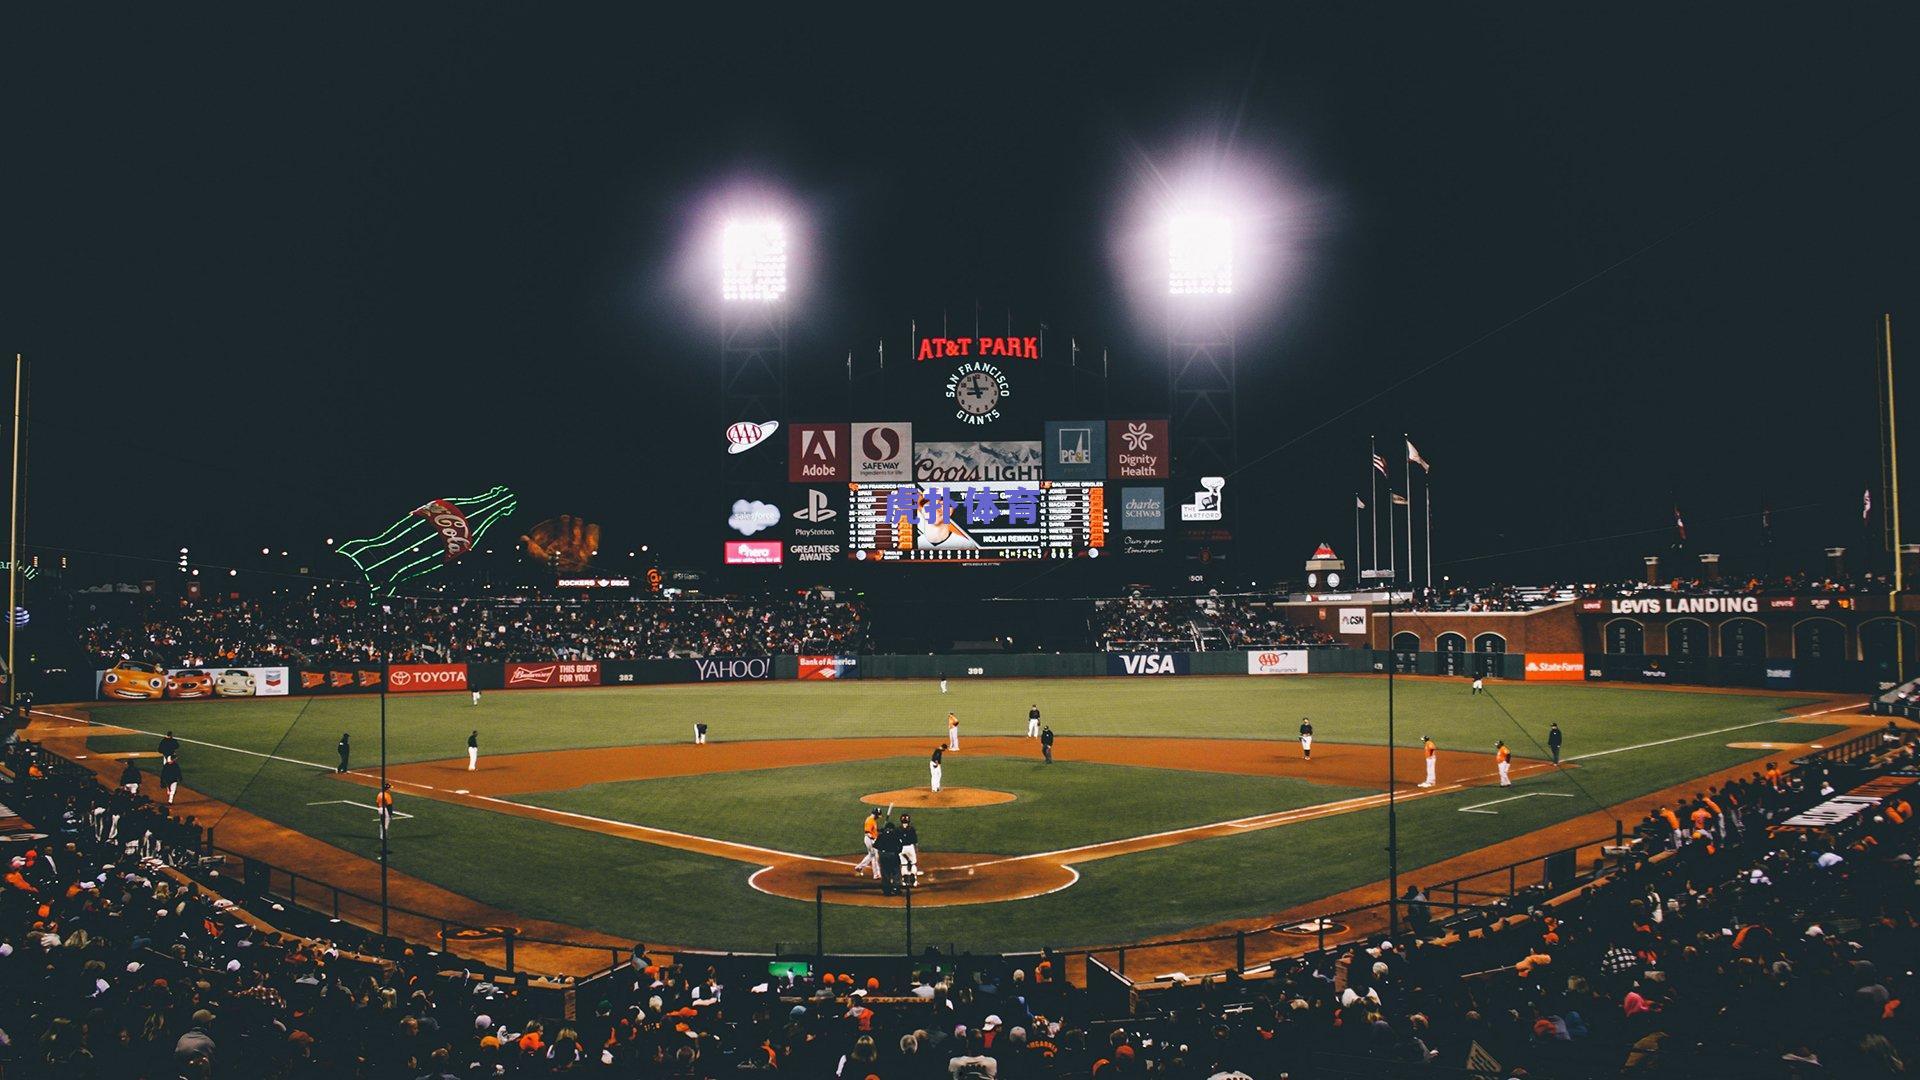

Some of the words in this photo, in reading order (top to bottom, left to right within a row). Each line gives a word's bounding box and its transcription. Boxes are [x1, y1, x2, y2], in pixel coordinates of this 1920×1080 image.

[918, 338, 972, 360] AT&T
[979, 337, 1038, 359] PARK
[946, 374, 959, 398] SAN
[958, 361, 1009, 397] FRANCISCO
[956, 409, 1000, 425] GIANTS
[1062, 449, 1090, 462] PG&E
[1119, 454, 1157, 467] Dignity
[803, 464, 836, 476] Adobe
[862, 462, 899, 470] SAFEWAY
[916, 458, 981, 481] Coors
[984, 465, 1042, 481] LIGHT
[1121, 467, 1156, 476] Health
[1126, 499, 1160, 510] charles
[1125, 509, 1161, 518] SCHWAB
[795, 529, 834, 537] PlayStation
[790, 545, 840, 553] GREATNESS
[799, 553, 831, 561] AWAITS
[1666, 598, 1758, 613] LANDING
[1349, 616, 1364, 625] CSN
[819, 657, 826, 665] of
[827, 657, 856, 665] America
[1119, 655, 1175, 674] VISA
[560, 665, 576, 673] THIS
[576, 664, 597, 672] BUD'S
[695, 658, 770, 680] YAHOO!
[413, 671, 466, 683] TOYOTA
[560, 674, 573, 682] FOR
